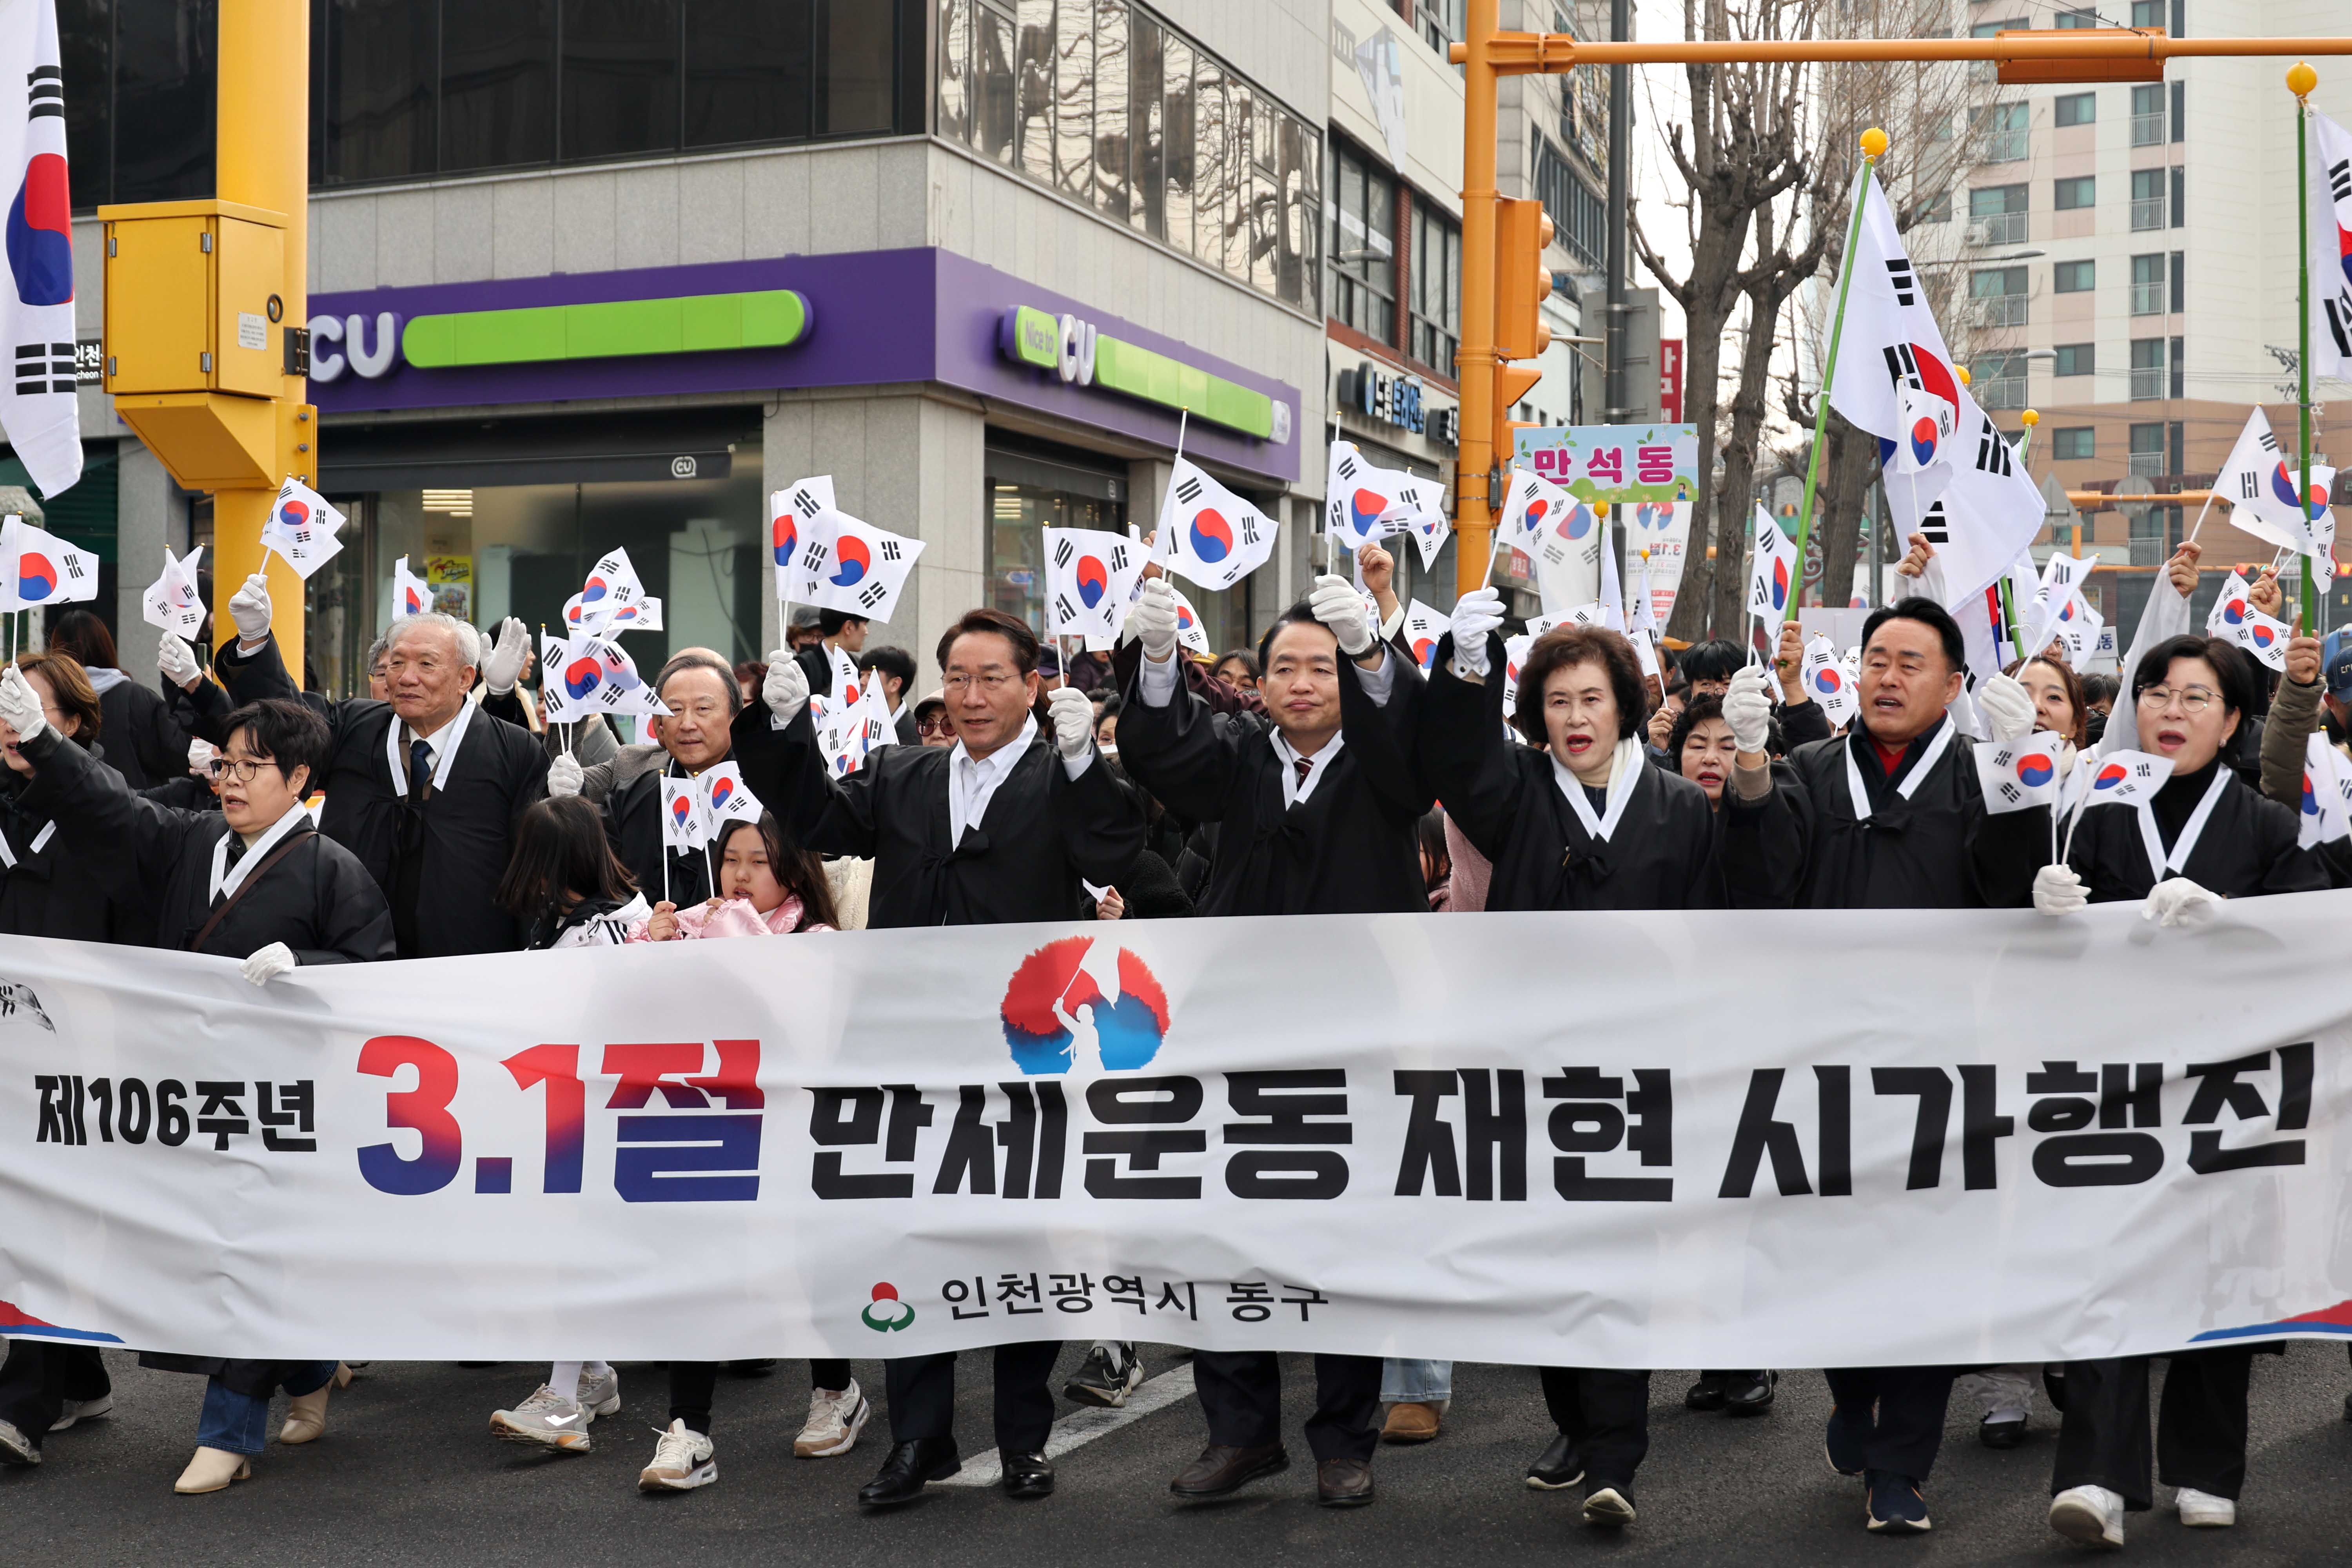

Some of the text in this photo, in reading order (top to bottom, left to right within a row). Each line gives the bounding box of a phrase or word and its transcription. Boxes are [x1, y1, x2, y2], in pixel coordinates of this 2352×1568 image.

[75, 344, 103, 367] 인천
[307, 312, 394, 383] CU
[1025, 314, 1096, 385] Nice to CU
[76, 370, 99, 379] cheon
[1534, 446, 1673, 485] 만석동
[35, 1035, 2314, 1203] 제106주년 3.1절 만세운동 재현 시가행진
[941, 1272, 1329, 1323] 인천광역시 동구
